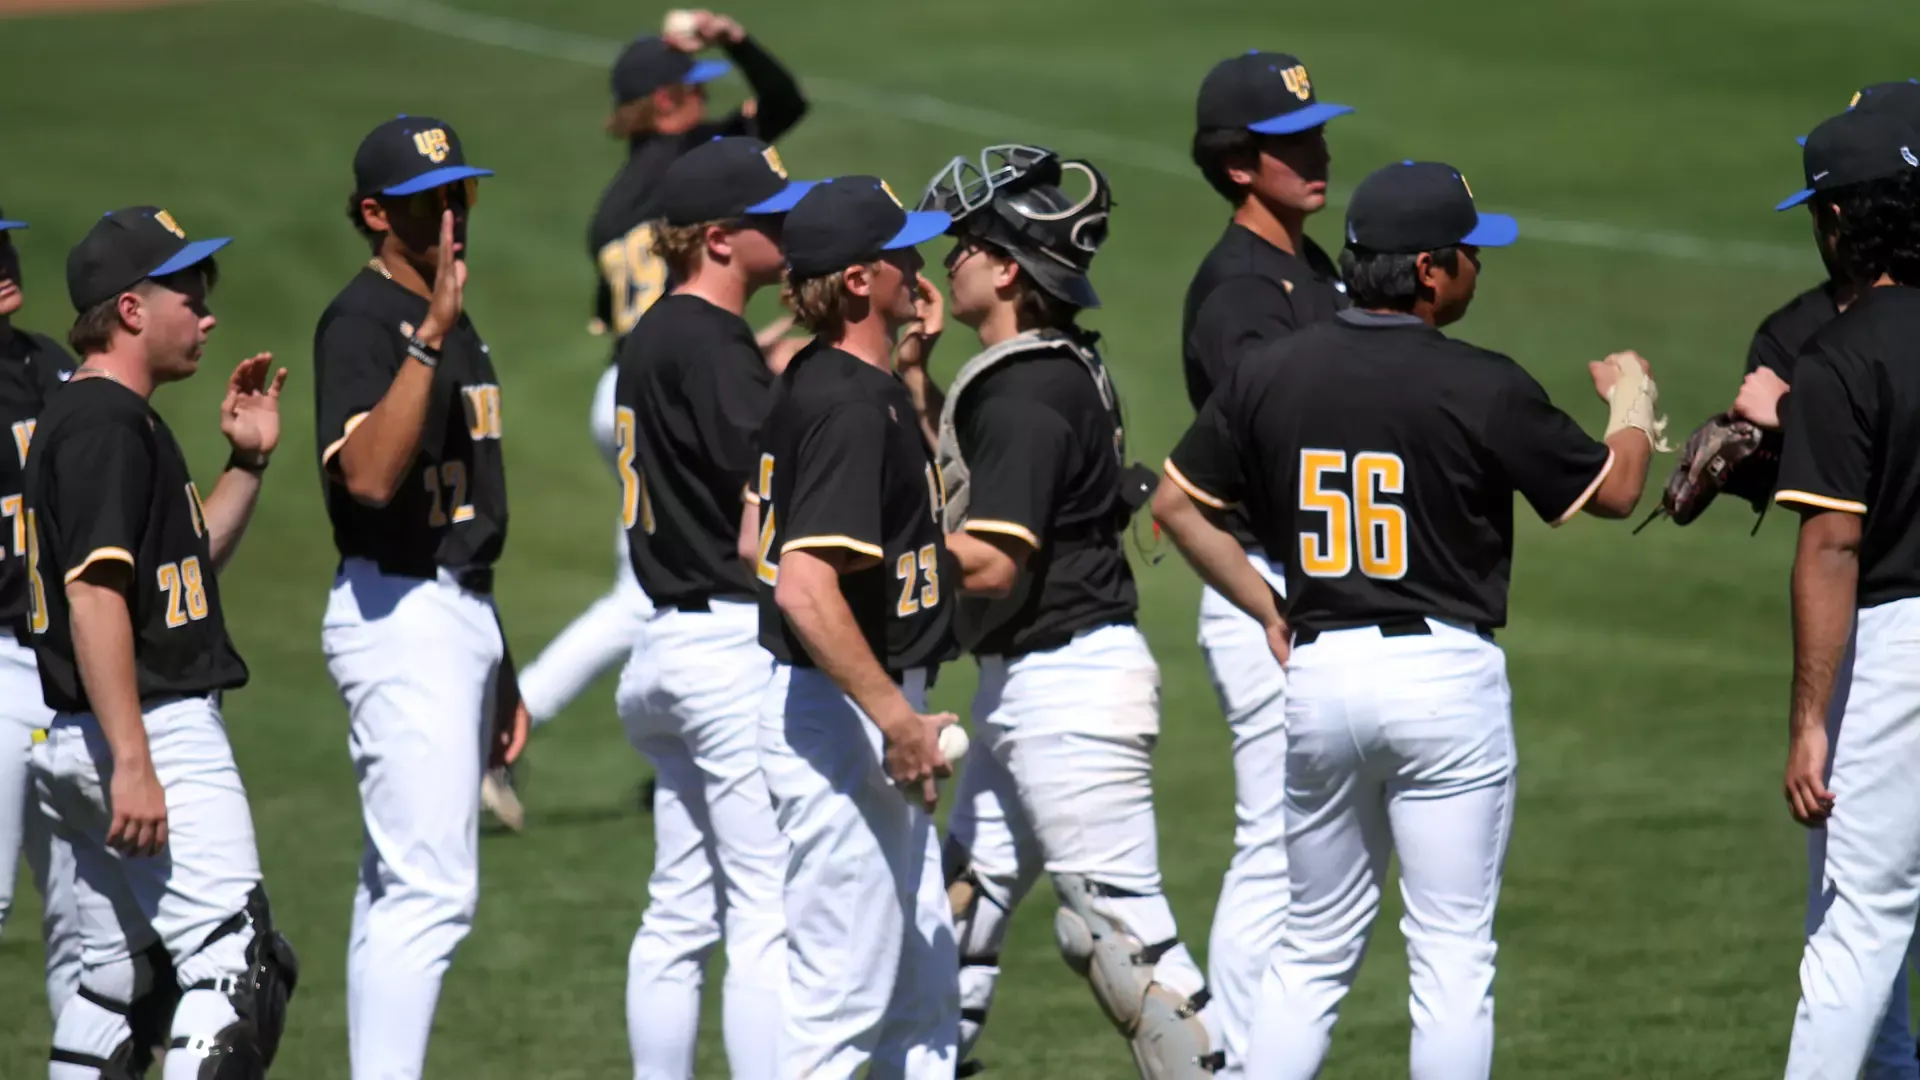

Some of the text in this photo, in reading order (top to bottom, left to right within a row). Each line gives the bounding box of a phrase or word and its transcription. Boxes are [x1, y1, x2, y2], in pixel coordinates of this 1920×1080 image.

[1299, 448, 1408, 580] 56
[157, 556, 208, 629] 28
[897, 543, 939, 617] 23
